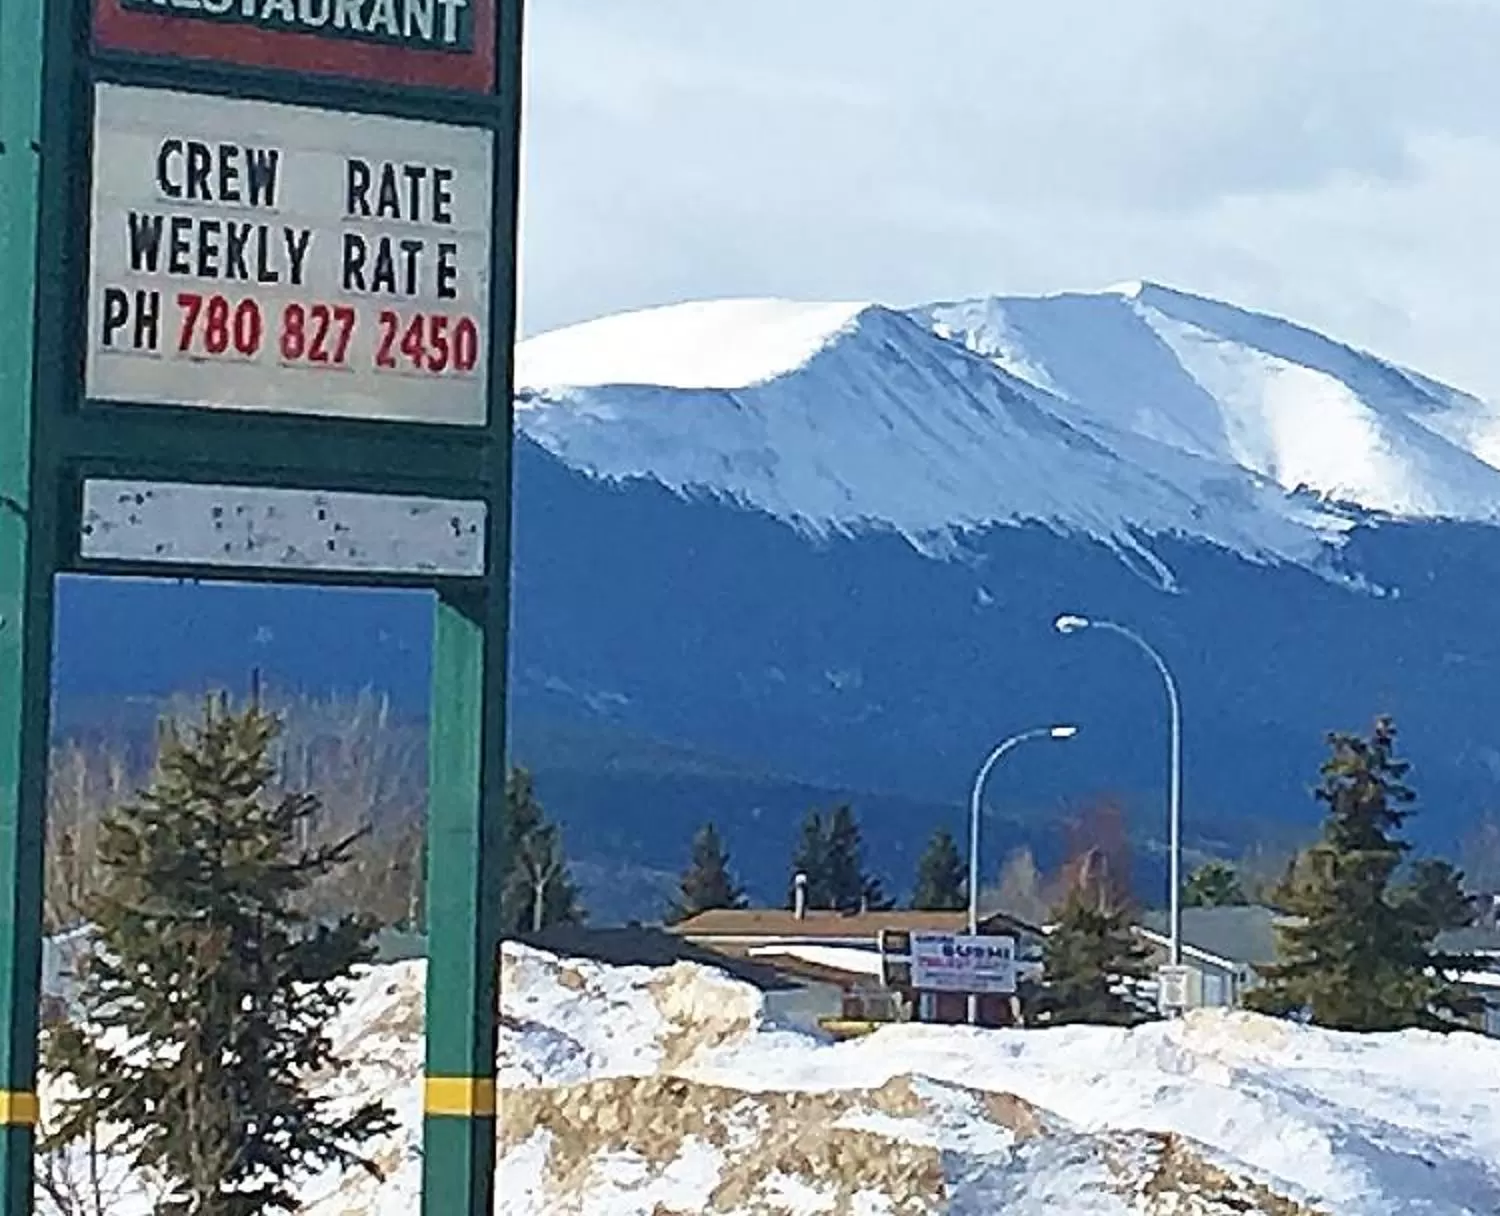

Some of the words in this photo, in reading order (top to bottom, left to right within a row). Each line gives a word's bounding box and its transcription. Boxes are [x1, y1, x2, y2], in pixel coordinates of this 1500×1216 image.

[156, 139, 279, 207] CREW
[346, 159, 453, 224] RATE
[128, 212, 311, 285] WEEKLY
[343, 233, 458, 299] RATE
[103, 288, 160, 350] PH
[176, 294, 262, 355] 780
[279, 303, 355, 364] 827
[375, 311, 479, 372] 2450
